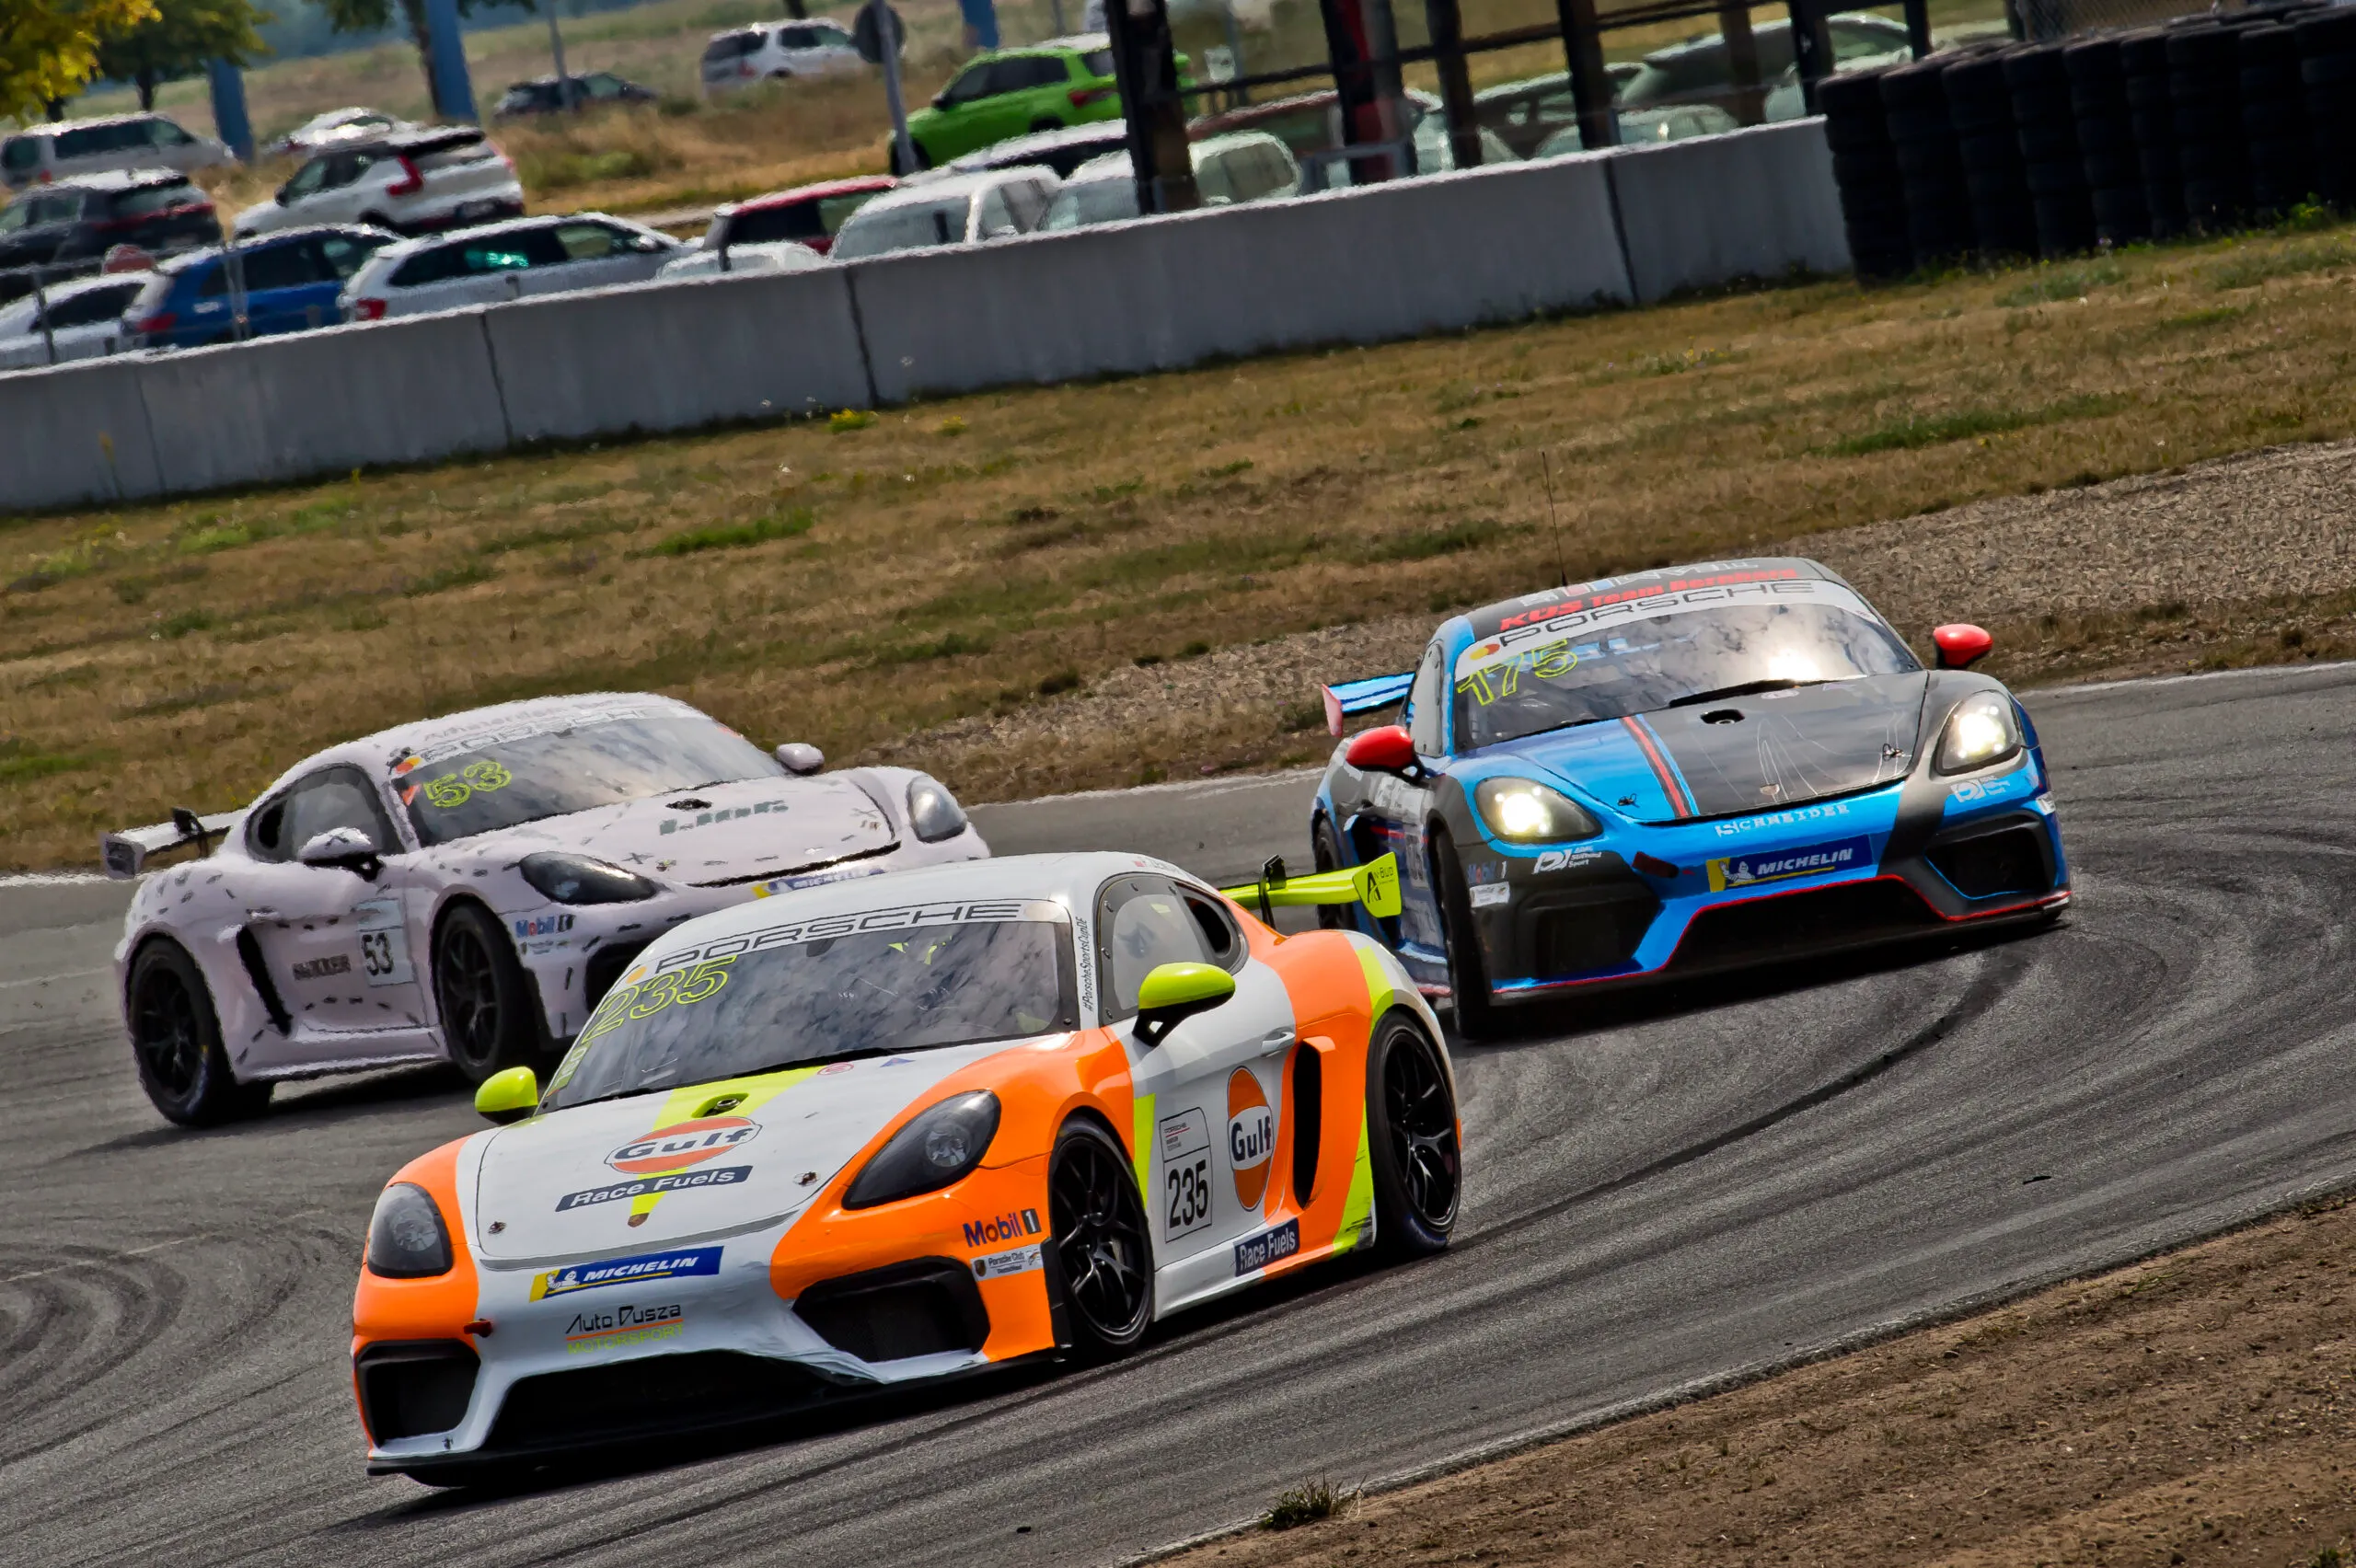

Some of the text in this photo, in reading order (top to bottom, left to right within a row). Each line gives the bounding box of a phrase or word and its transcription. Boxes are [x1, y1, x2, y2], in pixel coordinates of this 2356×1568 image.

[1499, 582, 1815, 647] PORSCHE
[1457, 639, 1578, 707] 175
[423, 760, 513, 808] 53
[1501, 860, 1508, 879] 1
[1757, 847, 1854, 875] MICHELIN
[361, 932, 394, 975] 53
[654, 904, 1022, 974] PORSCHE
[582, 954, 737, 1044] 235
[613, 1127, 755, 1159] Gulf
[1231, 1115, 1272, 1162] Gulf
[571, 1170, 736, 1207] Race Fuels
[1168, 1159, 1208, 1228] 235
[963, 1210, 1037, 1248] Mobil 1
[1240, 1228, 1296, 1270] Race Fuels
[583, 1255, 699, 1282] MICHELIN
[566, 1313, 613, 1334] Auto
[567, 1323, 685, 1355] MOTORSPORT
